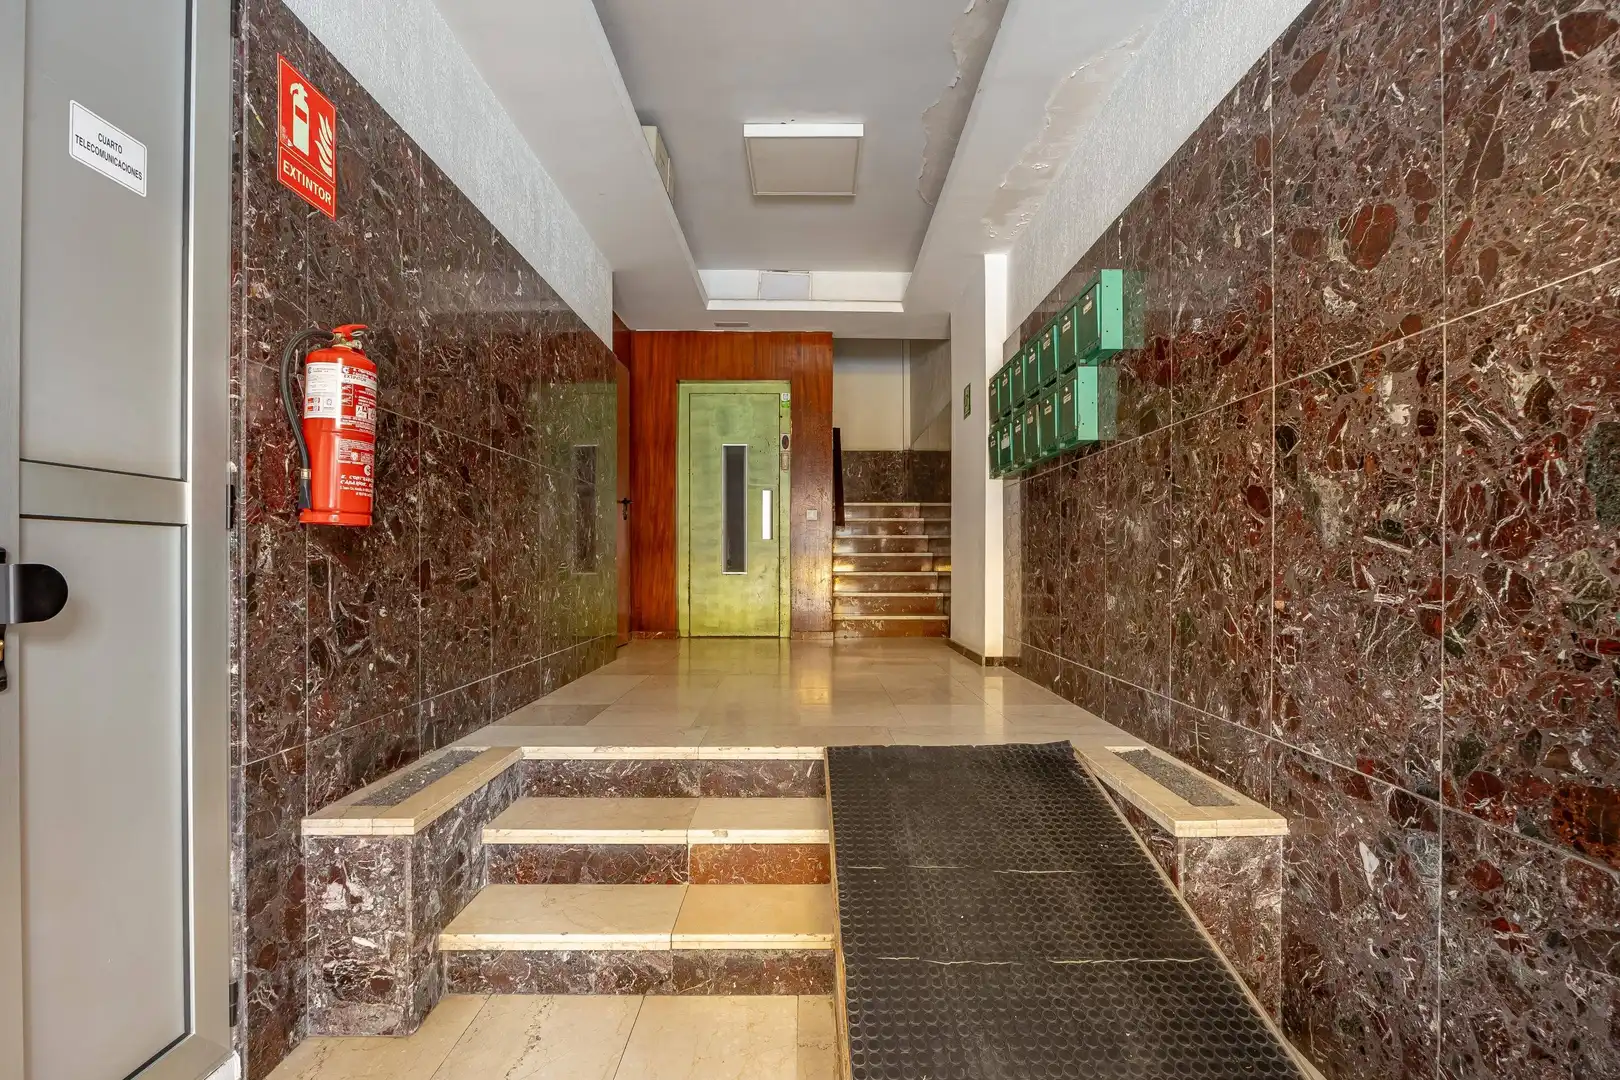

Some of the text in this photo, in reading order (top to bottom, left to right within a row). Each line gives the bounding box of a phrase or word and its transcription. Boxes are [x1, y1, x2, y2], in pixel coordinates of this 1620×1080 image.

[75, 134, 142, 181] TELECOMUNICACIONES
[98, 133, 123, 154] CUARTO
[283, 159, 332, 206] EXTINTOR
